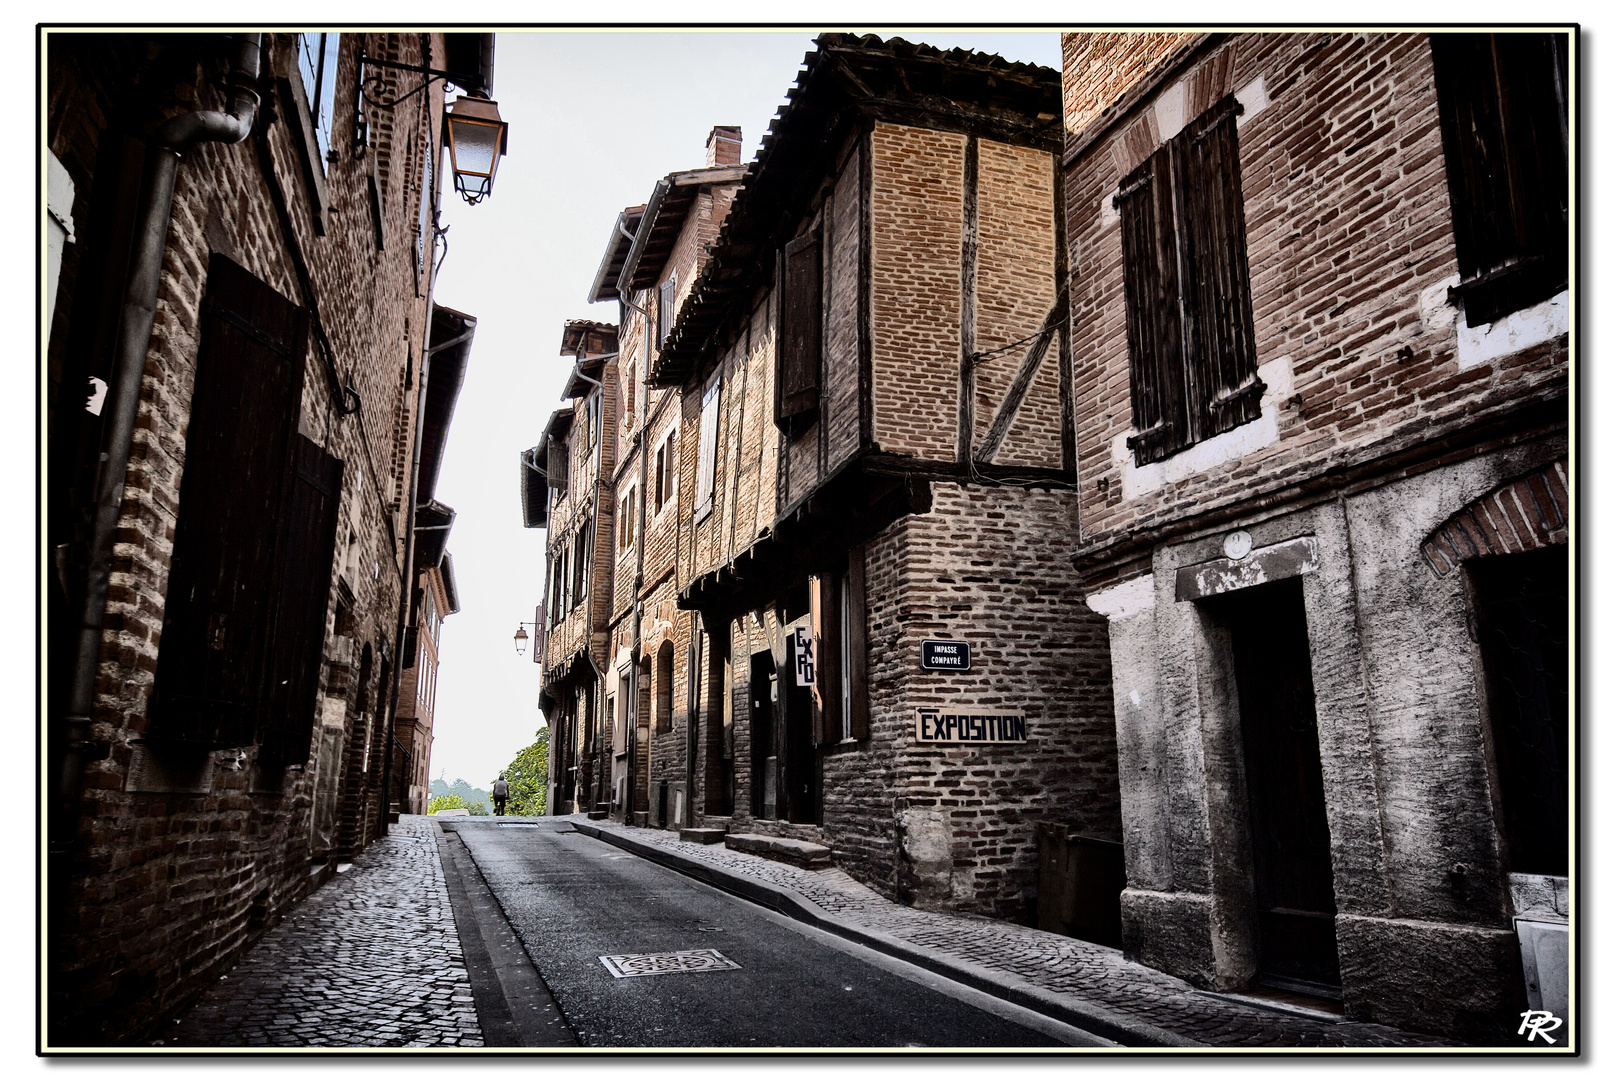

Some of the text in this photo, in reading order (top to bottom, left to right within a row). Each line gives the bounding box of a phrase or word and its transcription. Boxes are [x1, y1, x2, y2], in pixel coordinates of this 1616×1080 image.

[796, 627, 815, 683] EXPO
[934, 645, 958, 654] IMPASSE
[931, 655, 962, 665] COMPAYRÉ
[921, 714, 1027, 741] EXPOSITION
